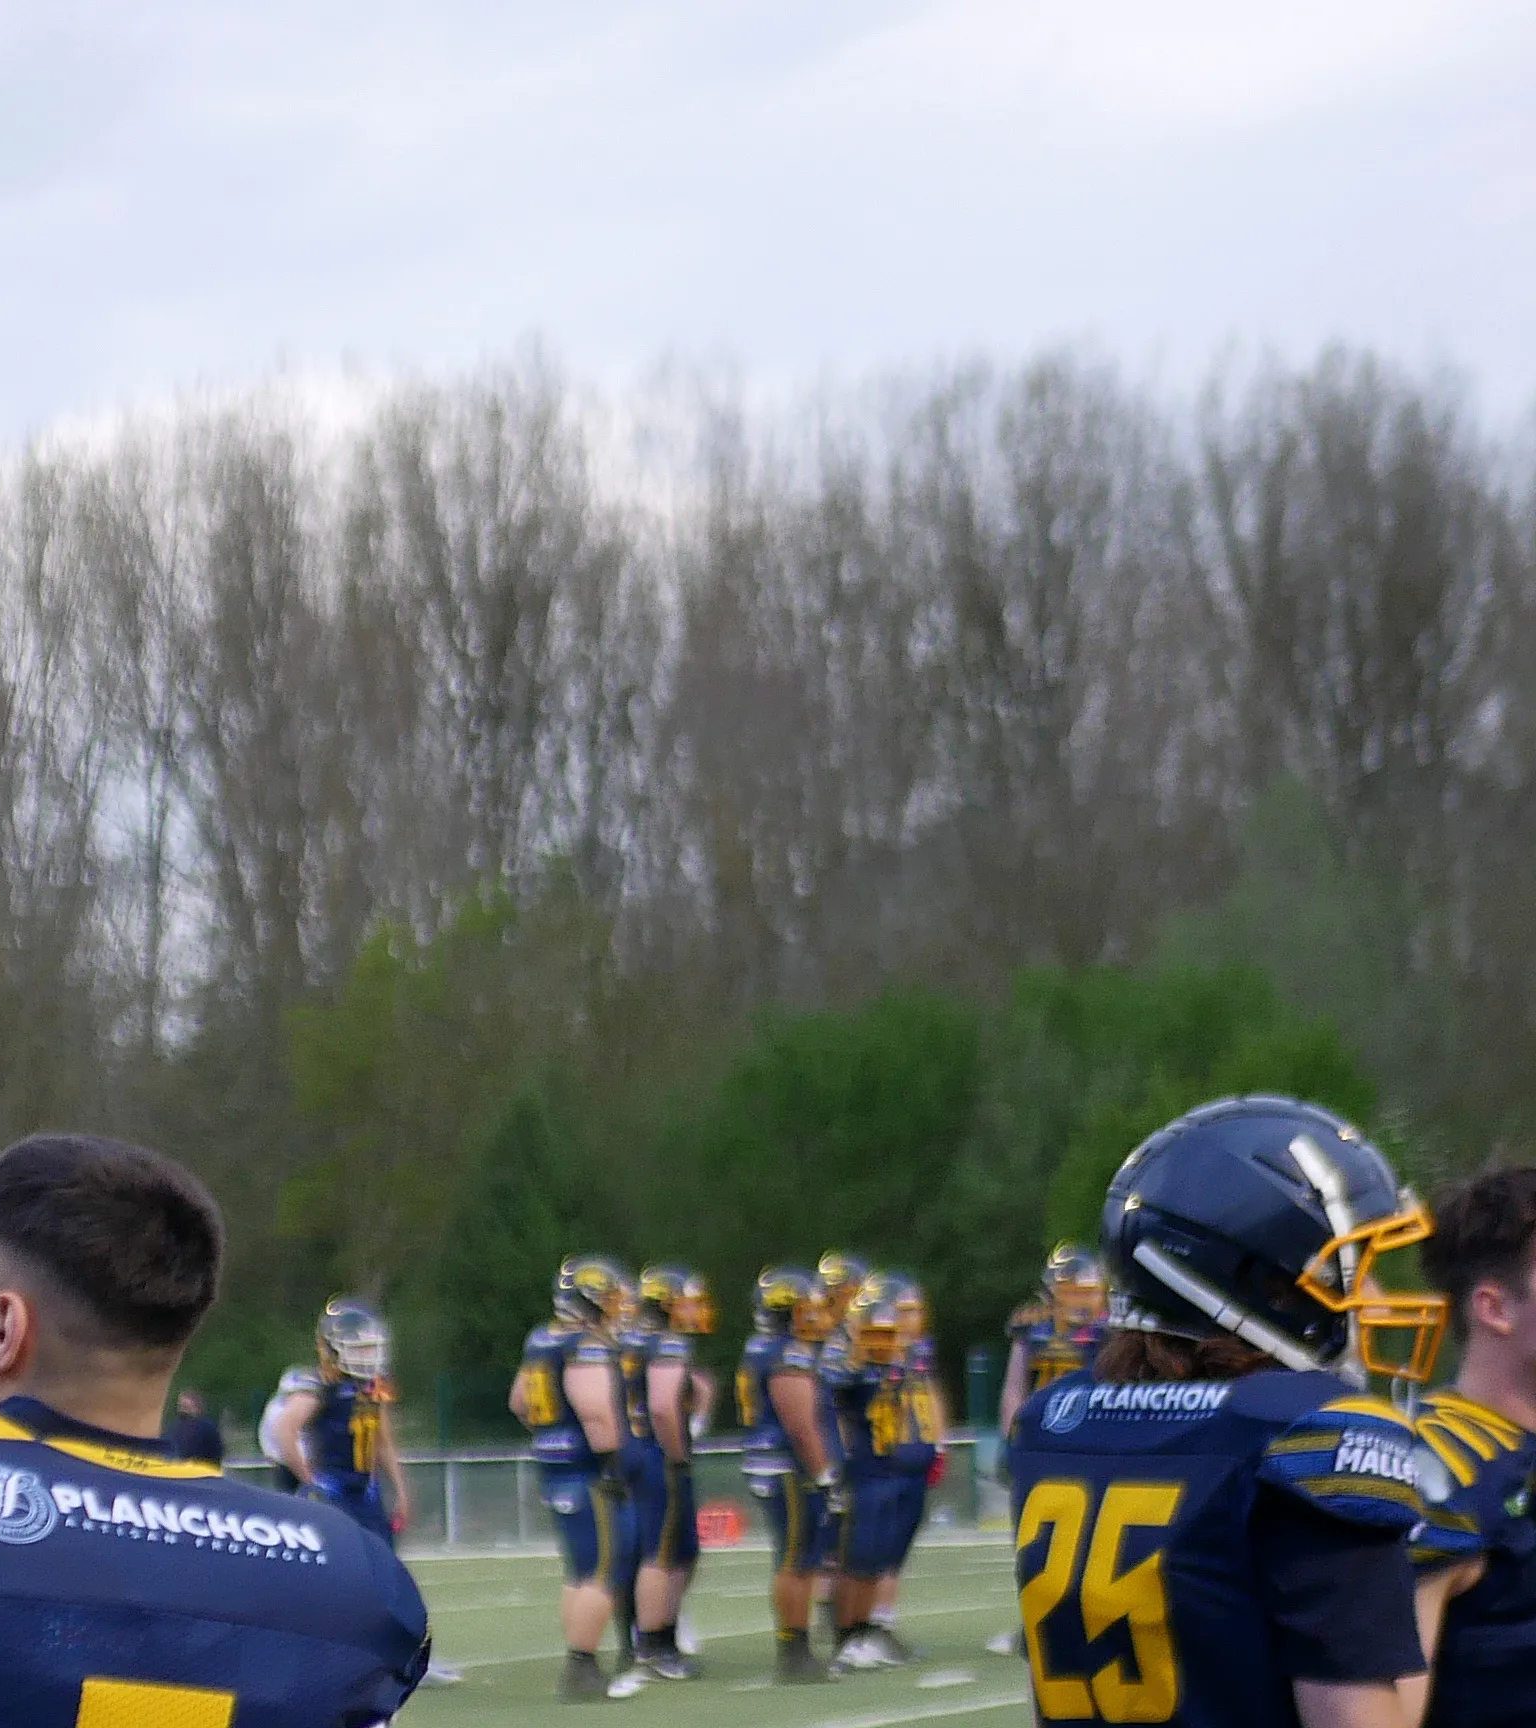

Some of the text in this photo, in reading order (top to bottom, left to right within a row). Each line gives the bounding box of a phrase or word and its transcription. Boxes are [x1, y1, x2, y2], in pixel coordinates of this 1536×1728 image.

[1087, 1384, 1231, 1411] PLANCHON
[49, 1483, 323, 1552] PLANCHON
[1017, 1483, 1184, 1723] 25
